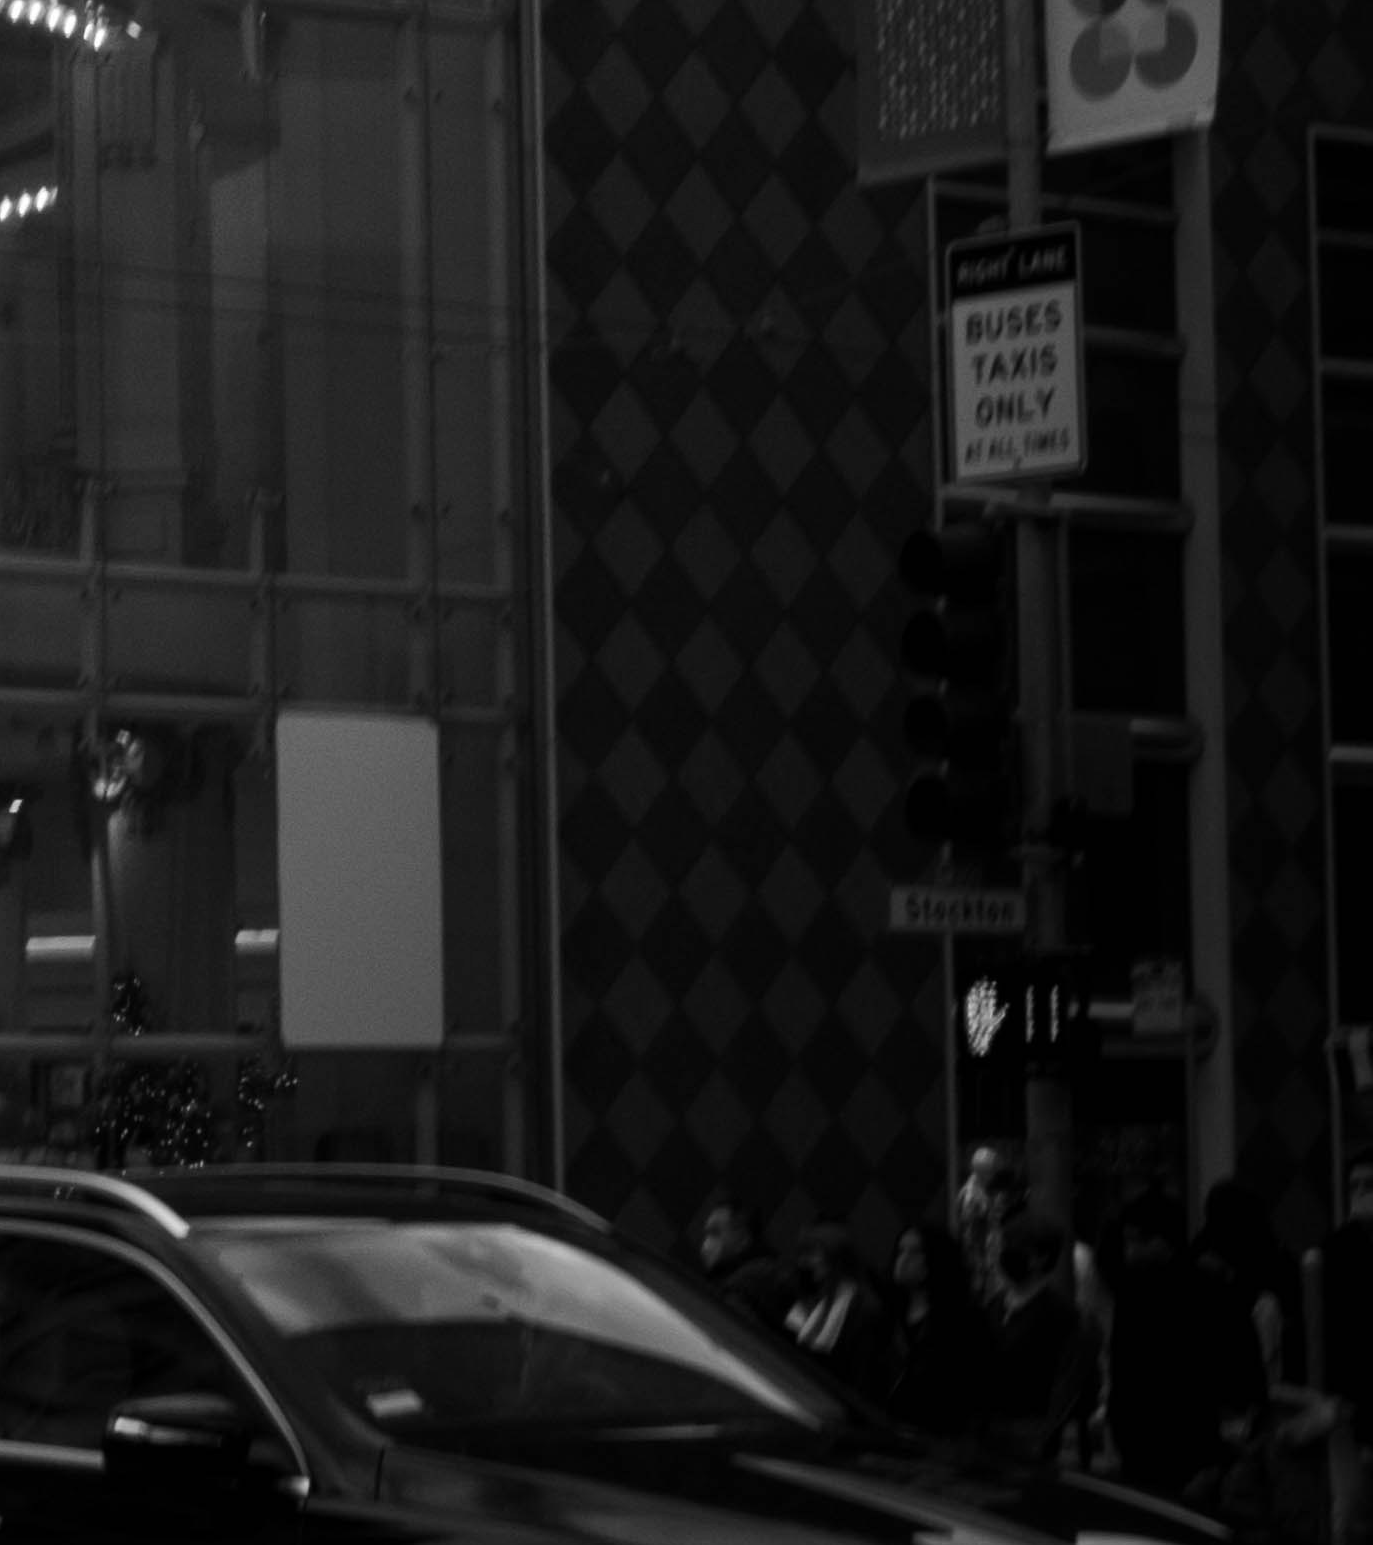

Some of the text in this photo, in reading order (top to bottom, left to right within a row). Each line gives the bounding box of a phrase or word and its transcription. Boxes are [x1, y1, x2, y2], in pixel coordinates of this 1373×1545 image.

[956, 242, 1069, 288] RIGHT LANE
[965, 299, 1062, 346] BUSES
[971, 343, 1058, 385] TAXIS
[975, 386, 1055, 428] ONLY
[964, 426, 1070, 464] AT ALL TIMES
[905, 892, 1014, 923] Stockton
